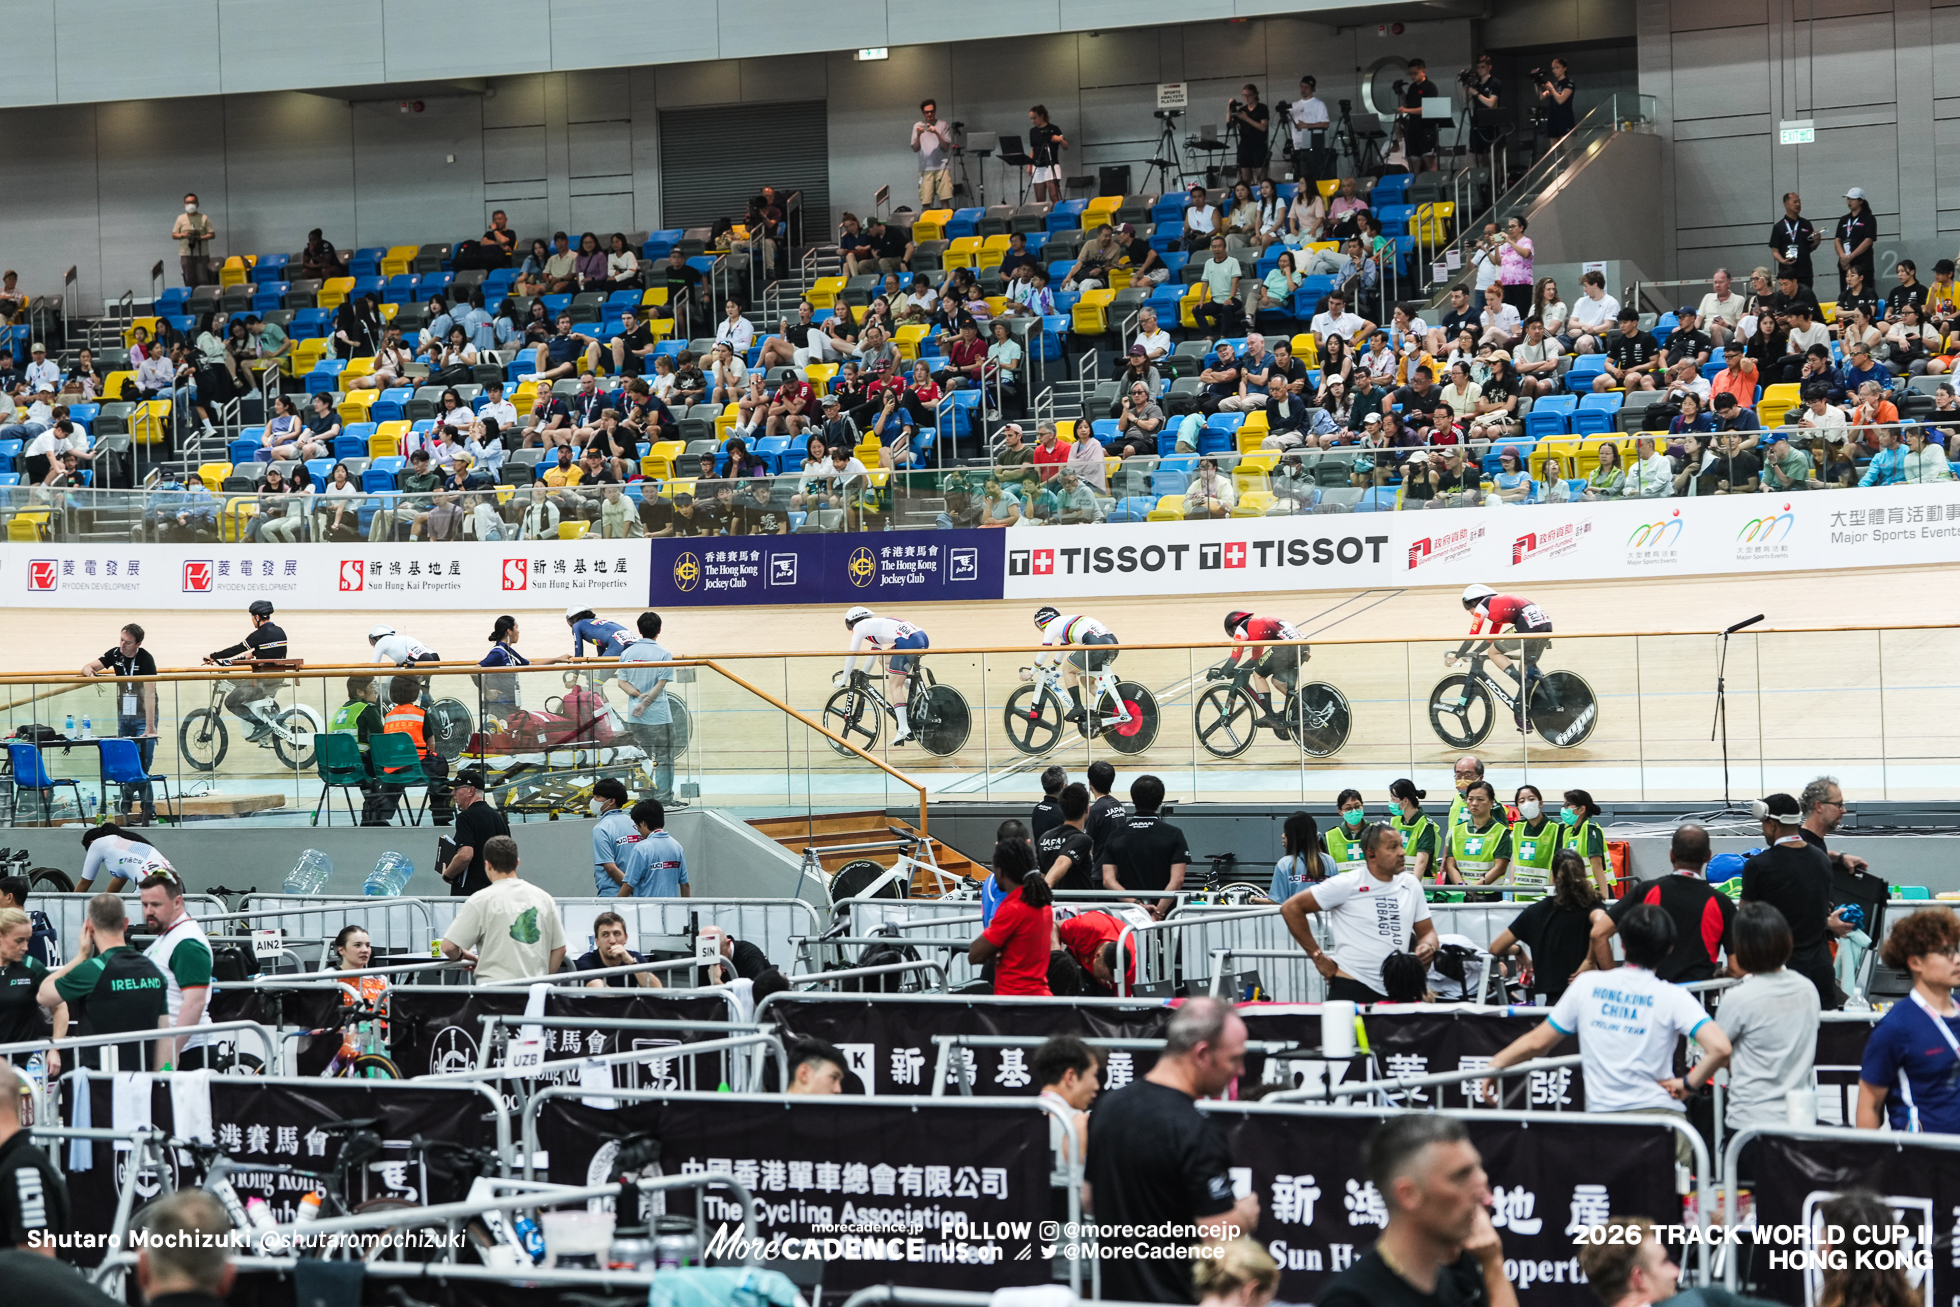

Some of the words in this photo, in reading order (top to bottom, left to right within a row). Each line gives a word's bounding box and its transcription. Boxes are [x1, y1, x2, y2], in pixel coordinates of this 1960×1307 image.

[1783, 131, 1799, 142] EXIT
[1881, 250, 1898, 279] 2
[1830, 529, 1867, 545] Major
[1873, 527, 1916, 544] Sports
[704, 550, 760, 562] 香港賽馬會
[880, 545, 939, 558] 香港賽馬會
[1252, 535, 1389, 568] TISSOT
[1418, 541, 1468, 566] Government-funded
[1444, 547, 1471, 562] programme
[1522, 537, 1573, 561] Government-funded
[1549, 542, 1577, 558] programme
[881, 559, 893, 571] The
[895, 559, 914, 574] Hong
[916, 558, 937, 573] Kong
[1060, 544, 1190, 574] TISSOT
[62, 560, 140, 576] 菱電發展
[218, 560, 297, 576] 菱電發展
[705, 564, 717, 575] The
[718, 564, 737, 578] Hong
[739, 564, 759, 577] Kong
[91, 583, 140, 591] DEVELOPMENT
[217, 583, 246, 591] RYODEN
[247, 583, 297, 591] DEVELOPMENT
[368, 581, 383, 590] Sun
[385, 581, 404, 592] Hung
[407, 580, 420, 590] Kai
[422, 580, 461, 591] Properties
[532, 579, 547, 589] Sun
[549, 579, 570, 590] Hung
[572, 579, 586, 588] Kai
[588, 578, 628, 590] Properties
[704, 577, 728, 591] Jockey
[729, 577, 747, 588] Club
[880, 573, 905, 587] Jockey
[906, 572, 925, 584] Club
[1485, 678, 1515, 710] KOGA
[845, 691, 853, 717] LOTUS
[1555, 701, 1595, 745] hope
[1105, 806, 1126, 817] JAPAN
[1375, 896, 1391, 936] TOBAGO
[1387, 898, 1403, 946] TRINIDAD
[256, 939, 280, 951] AIN2
[702, 946, 715, 957] SIN
[111, 977, 161, 992] IRELAND
[1593, 987, 1622, 1003] HONG
[1623, 994, 1654, 1007] KONG
[1602, 1003, 1638, 1020] CHINA
[513, 1053, 538, 1067] UZB
[704, 1196, 743, 1220] The
[754, 1197, 832, 1227] Cycling
[1269, 1240, 1322, 1272] Sun
